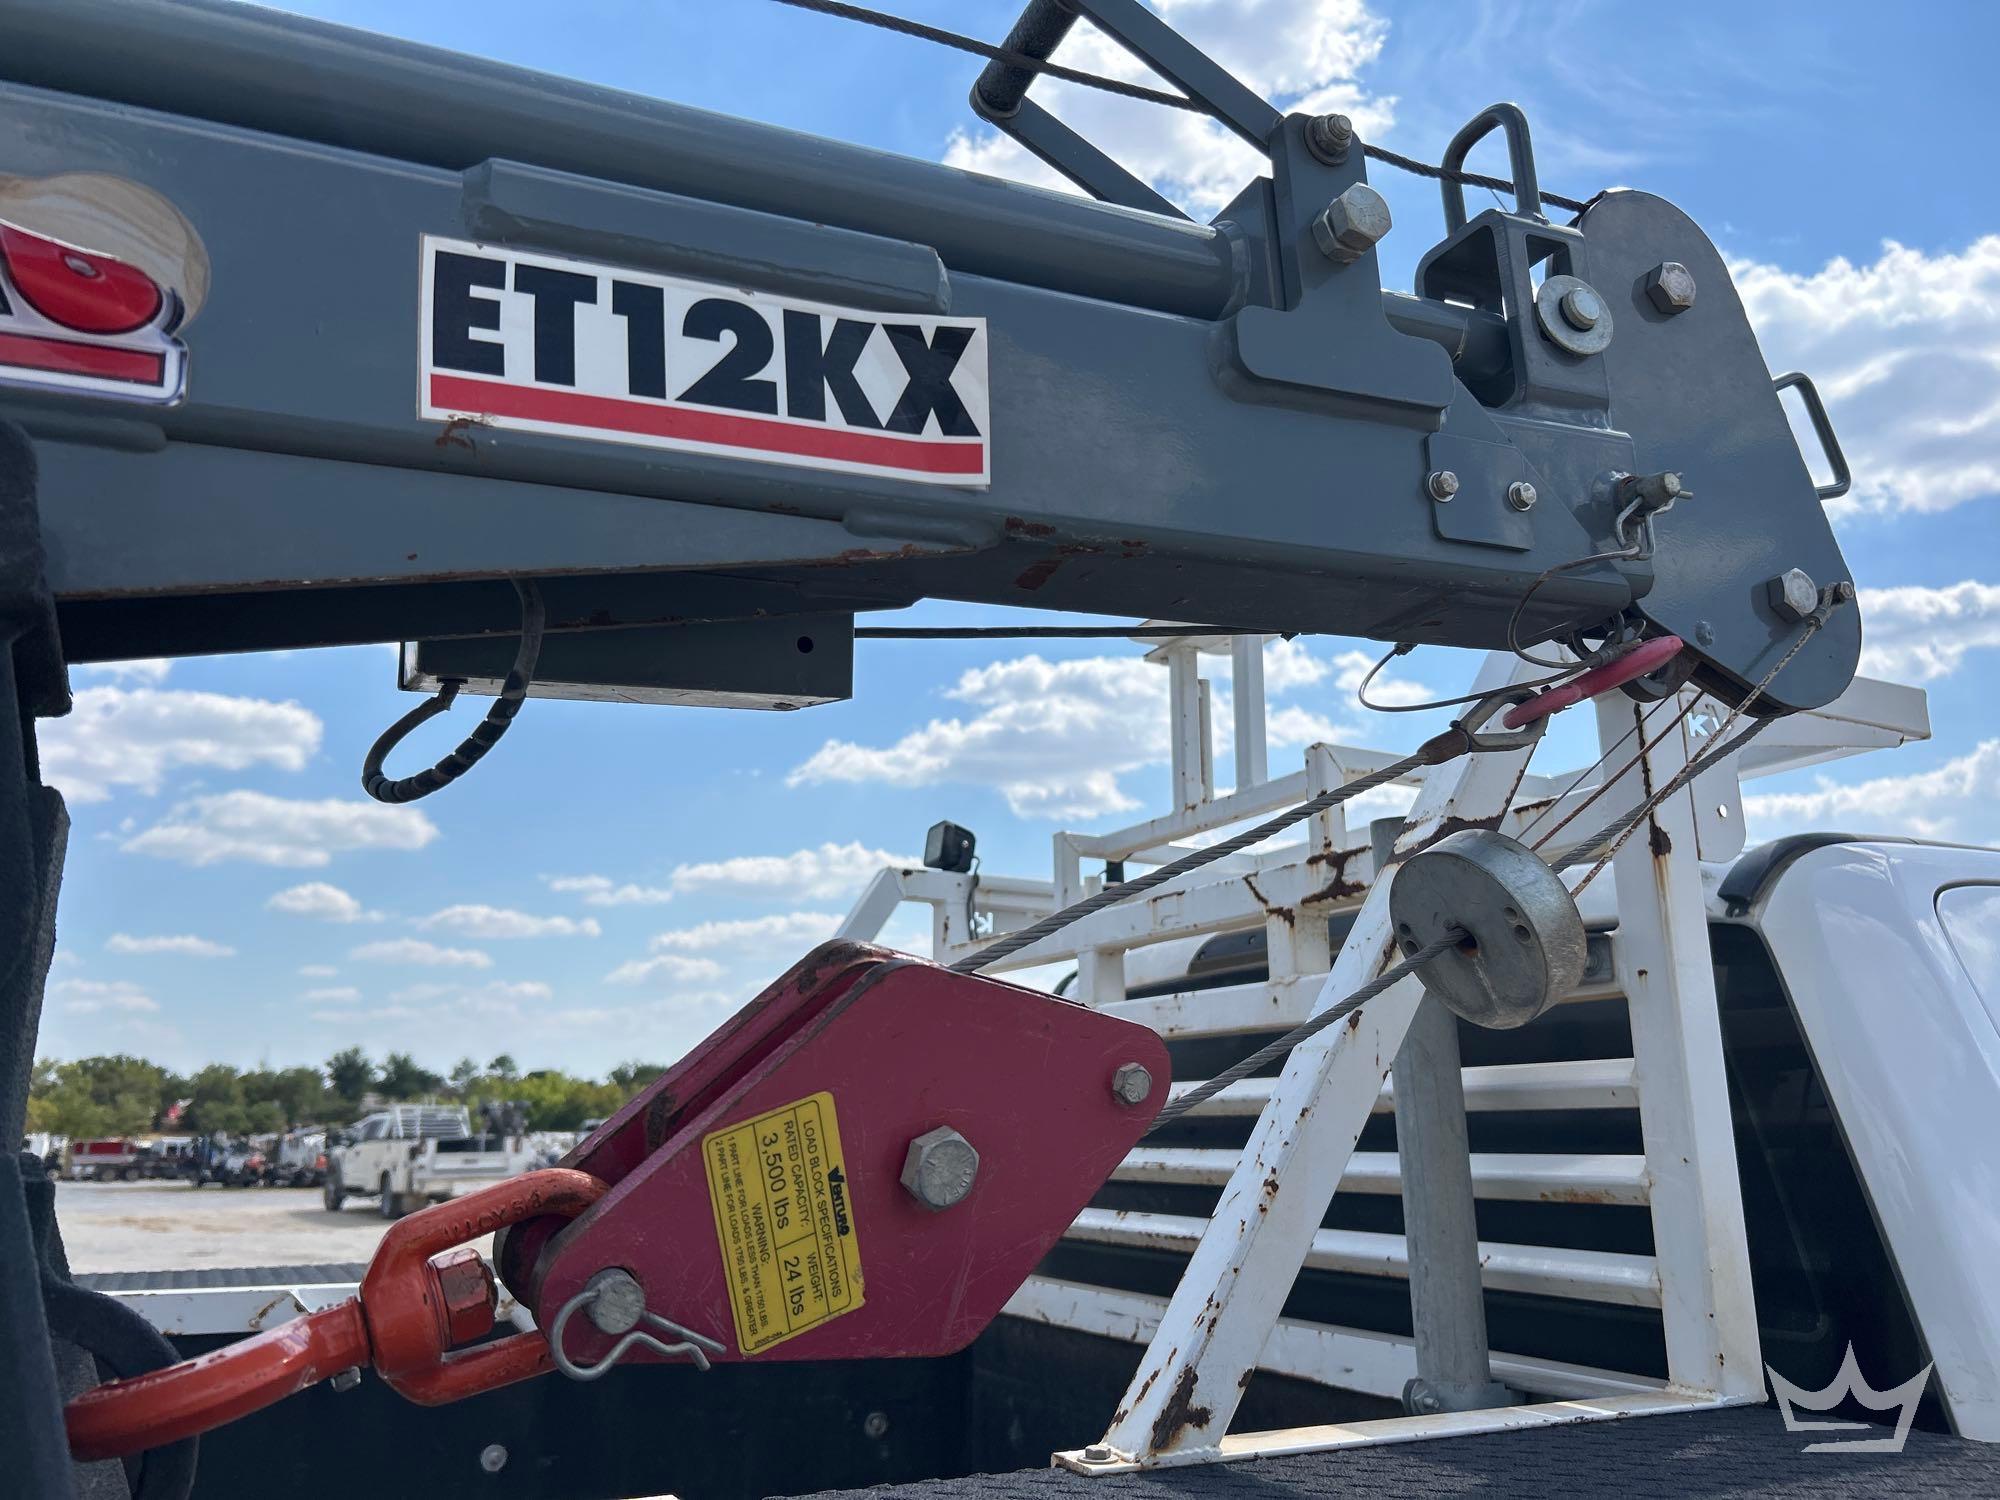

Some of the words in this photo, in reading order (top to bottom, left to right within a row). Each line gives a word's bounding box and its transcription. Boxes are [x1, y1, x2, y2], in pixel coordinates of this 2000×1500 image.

[432, 250, 982, 437] ET12KX
[761, 1132, 786, 1192] 3,500
[802, 1119, 817, 1154] LOAD
[783, 1119, 798, 1161] RATED
[791, 1163, 810, 1227] CAPACITY:
[809, 1155, 825, 1198] BLOCK
[827, 1164, 849, 1237] VENTURO
[751, 1201, 770, 1265] WARNING:
[773, 1196, 789, 1229] lbs
[783, 1255, 802, 1282] 24
[817, 1199, 841, 1297] SPECIFICATIONS
[788, 1284, 805, 1316] lbs
[806, 1251, 823, 1303] WEIGHT:
